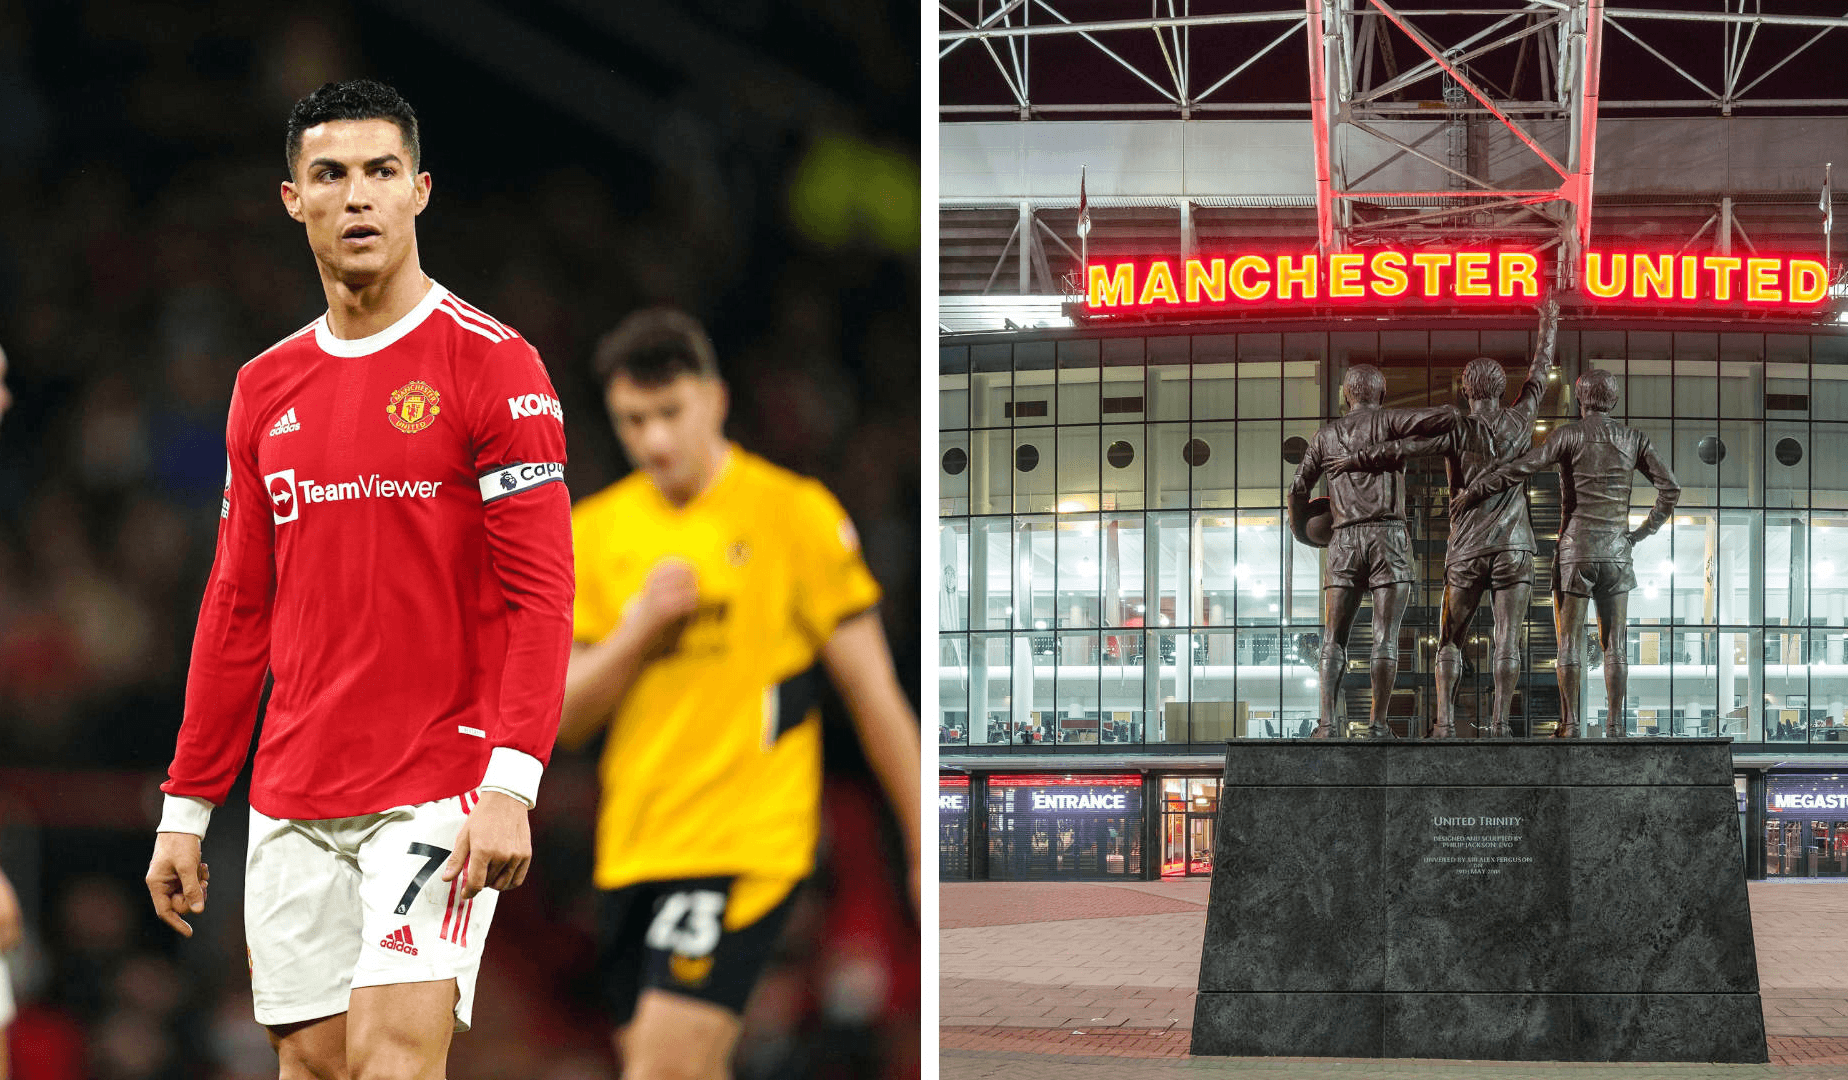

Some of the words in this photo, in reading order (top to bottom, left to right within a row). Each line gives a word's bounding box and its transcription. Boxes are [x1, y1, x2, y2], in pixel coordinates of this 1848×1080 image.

[1088, 251, 1539, 307] MANCHESTER
[1586, 253, 1829, 303] UNITED
[395, 384, 437, 402] MANCHESTER
[269, 422, 301, 437] adidas
[396, 421, 426, 431] UNITED
[298, 474, 443, 504] TeamViewer
[1034, 794, 1126, 809] ENTRANCE
[1774, 794, 1848, 808] MEGAST
[1434, 816, 1476, 827] UNITED
[1480, 816, 1522, 827] TRINITY
[394, 841, 452, 915] 7
[380, 939, 418, 956] adidas
